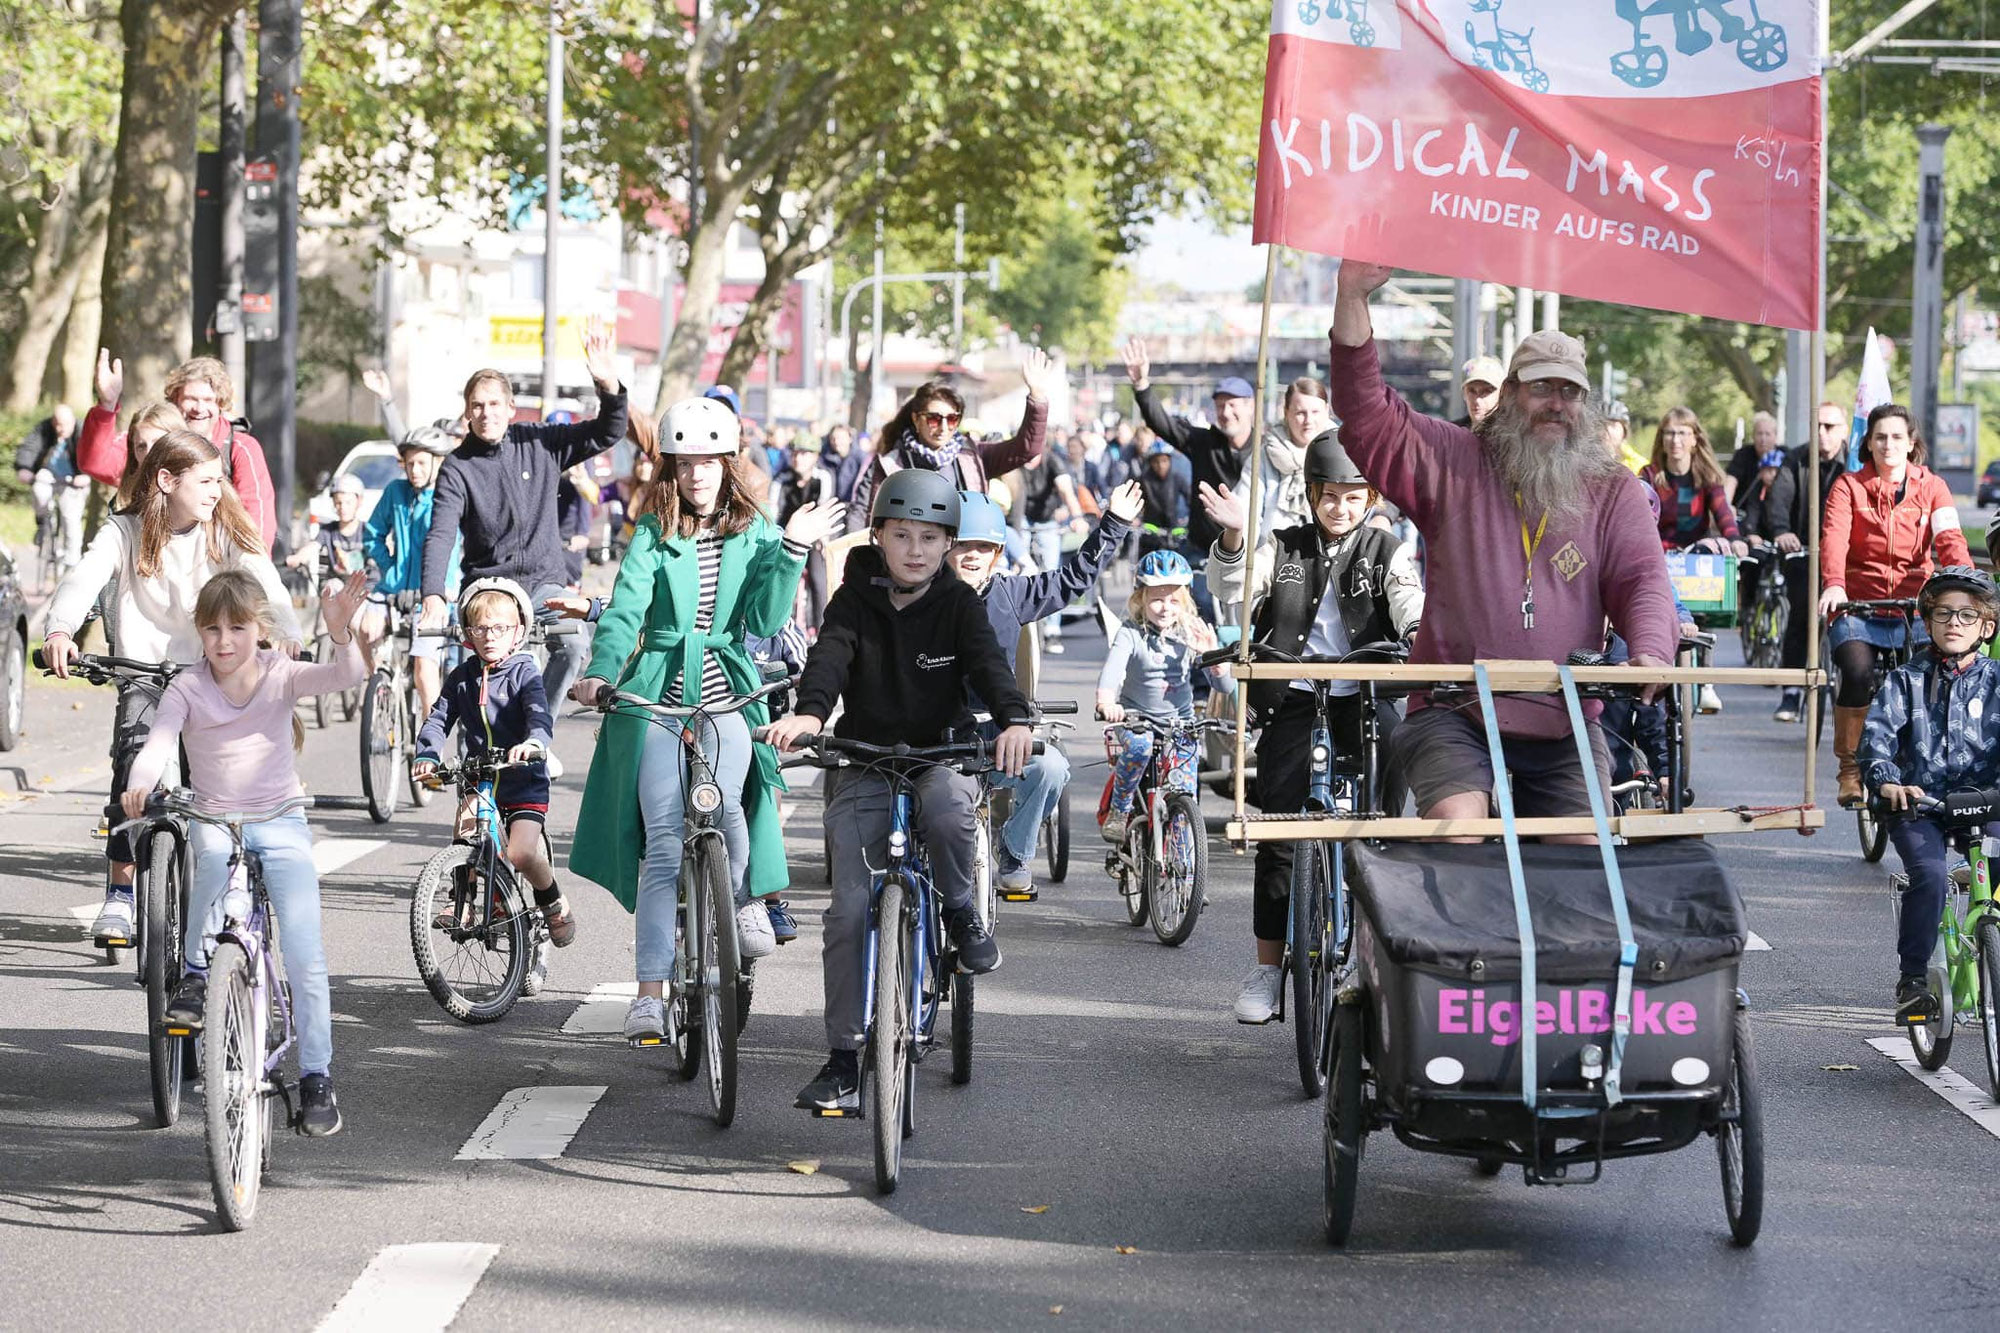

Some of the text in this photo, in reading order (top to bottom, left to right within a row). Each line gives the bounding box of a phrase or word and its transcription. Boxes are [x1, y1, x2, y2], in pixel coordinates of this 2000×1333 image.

[1271, 113, 1716, 221] KIDICAL MASS
[1734, 134, 1800, 187] Köln
[1429, 191, 1541, 231] KINDER
[1438, 989, 1699, 1046] EigelBke
